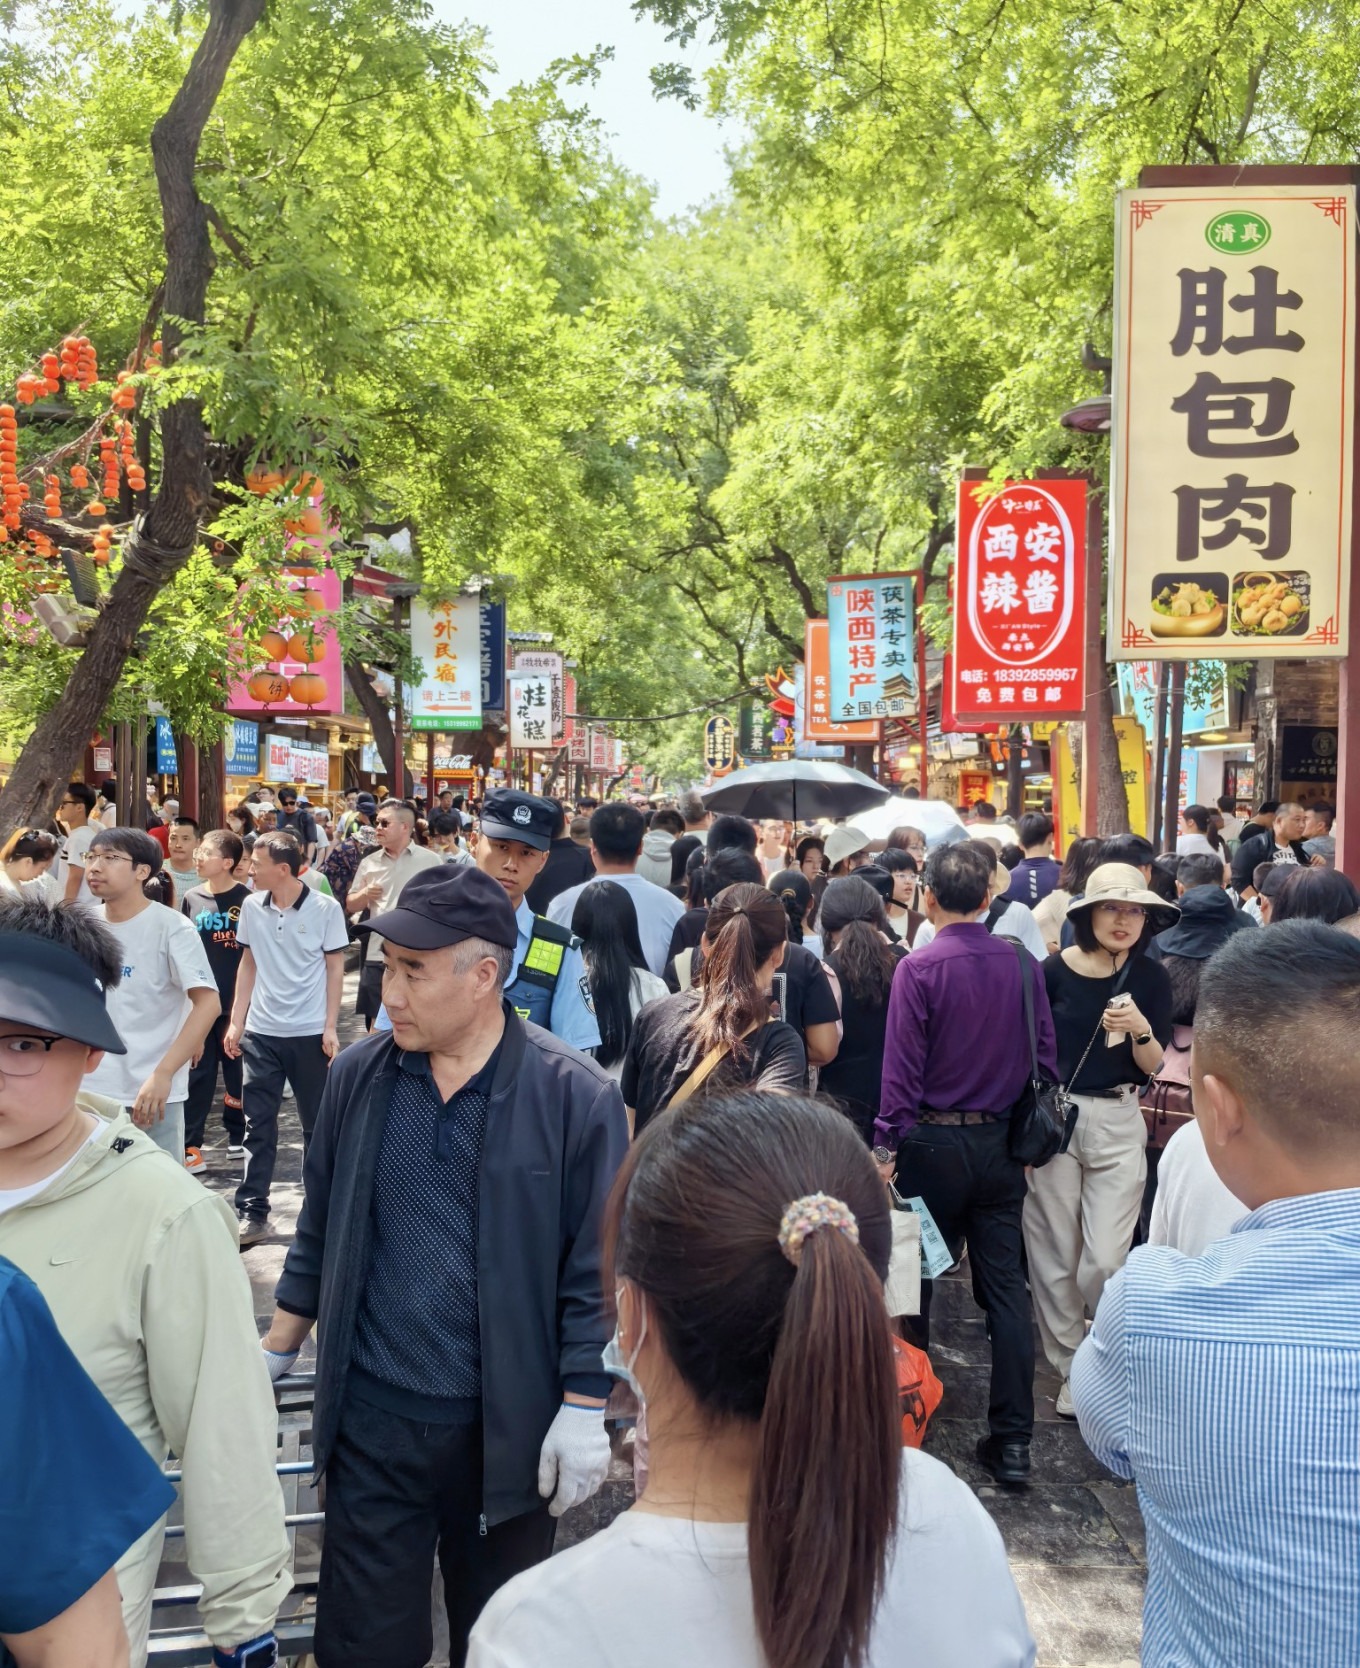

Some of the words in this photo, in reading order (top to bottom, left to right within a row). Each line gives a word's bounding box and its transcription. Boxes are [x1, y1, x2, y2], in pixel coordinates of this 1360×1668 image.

[1214, 222, 1261, 244] 清真
[1169, 265, 1306, 562] 肚包肉
[982, 521, 1063, 564] 西安
[979, 569, 1060, 617] 辣酱
[879, 584, 907, 668] 茯茶专卖
[846, 588, 877, 698] 陕西特产
[993, 668, 1078, 682] 18392859967
[422, 689, 472, 702] 请上二楼
[976, 686, 1062, 703] 免费包邮
[516, 682, 547, 741] 桂花糕
[841, 698, 905, 718] 全国包邮
[811, 716, 828, 724] TEA
[195, 911, 230, 933] JUST
